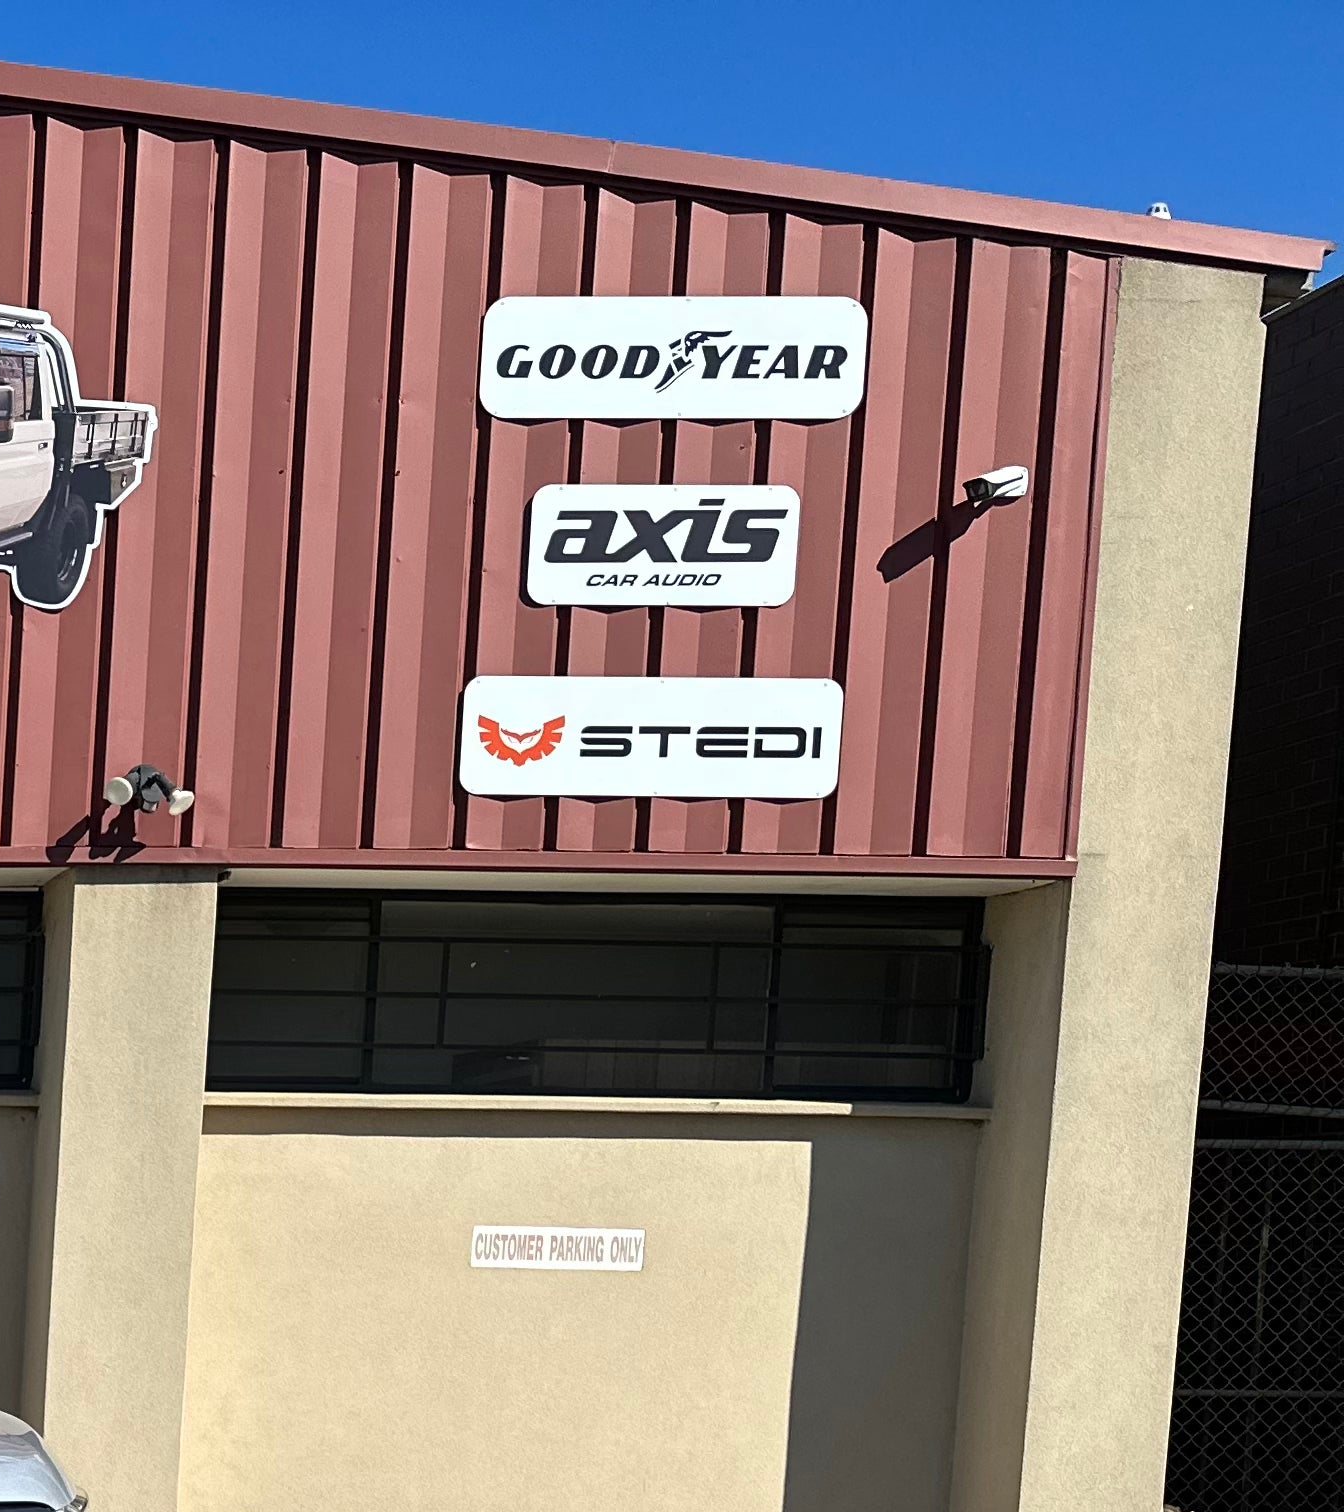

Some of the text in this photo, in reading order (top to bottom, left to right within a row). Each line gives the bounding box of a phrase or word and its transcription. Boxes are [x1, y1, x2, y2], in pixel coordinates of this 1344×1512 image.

[543, 498, 789, 563] axis
[586, 573, 722, 588] CAR AUDIO
[580, 726, 822, 758] STEDI
[474, 1232, 643, 1263] CUSTOMER PARKING ONLY
